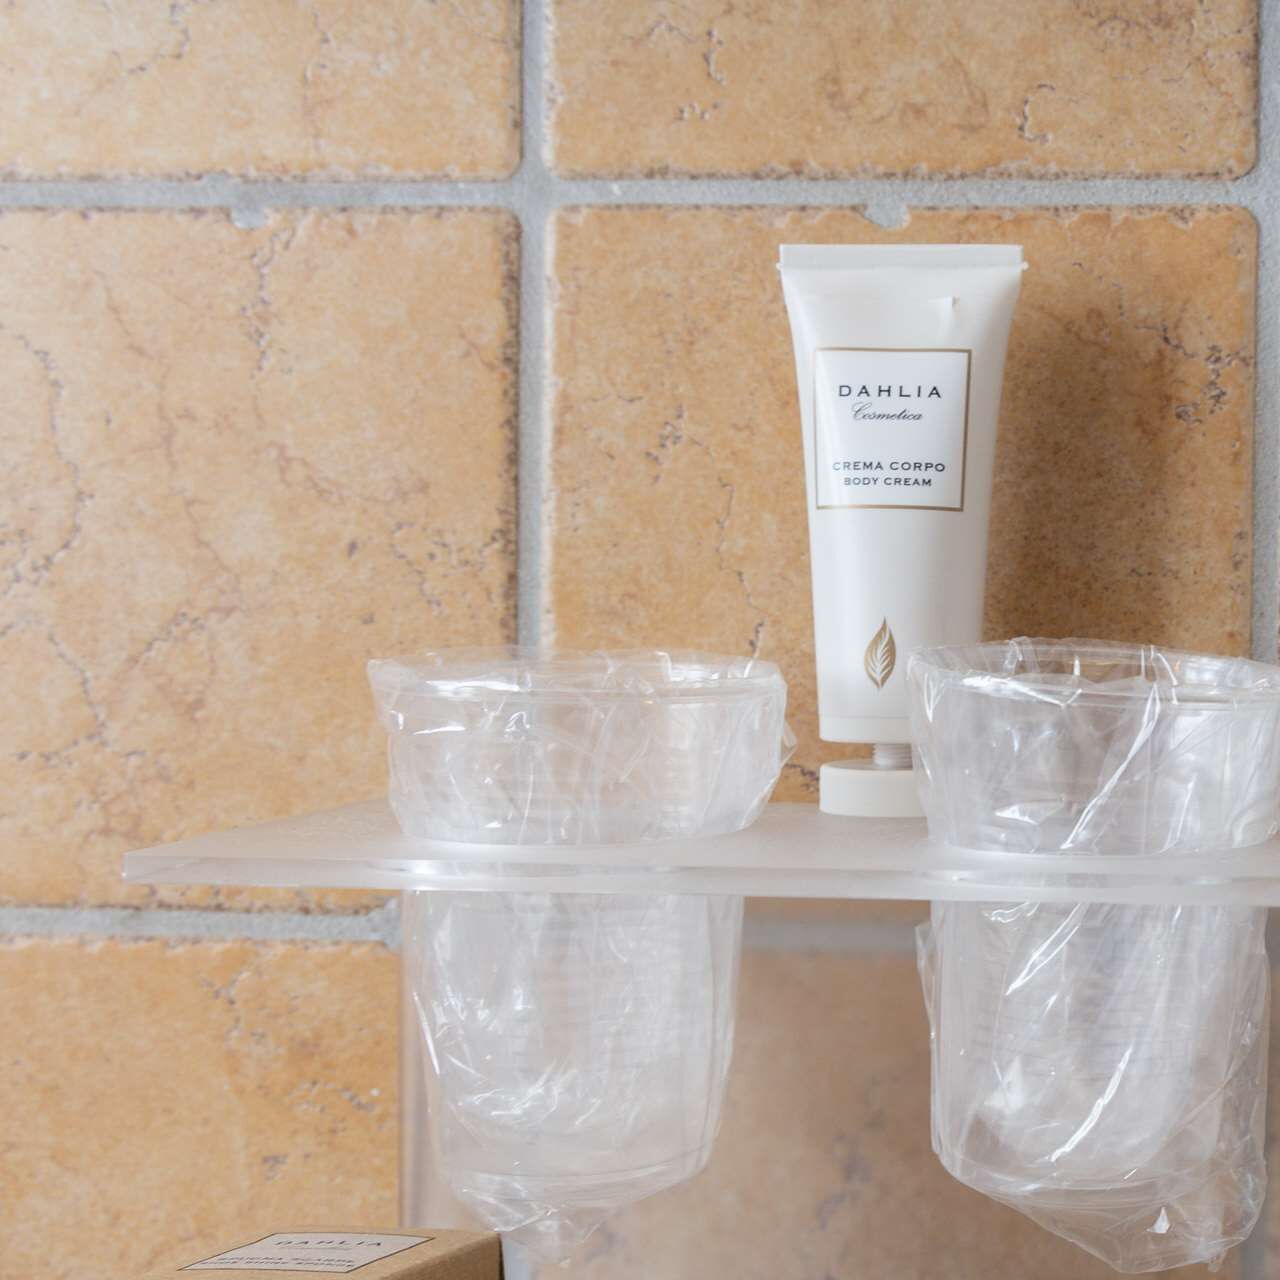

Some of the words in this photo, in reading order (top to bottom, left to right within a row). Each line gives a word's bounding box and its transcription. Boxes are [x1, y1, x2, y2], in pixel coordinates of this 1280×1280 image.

[838, 385, 942, 399] DAHLIA
[851, 401, 923, 421] Cosmetica
[832, 461, 884, 471] CREMA
[889, 461, 946, 472] CORPO
[843, 477, 879, 486] BODY
[883, 477, 932, 487] CREAM
